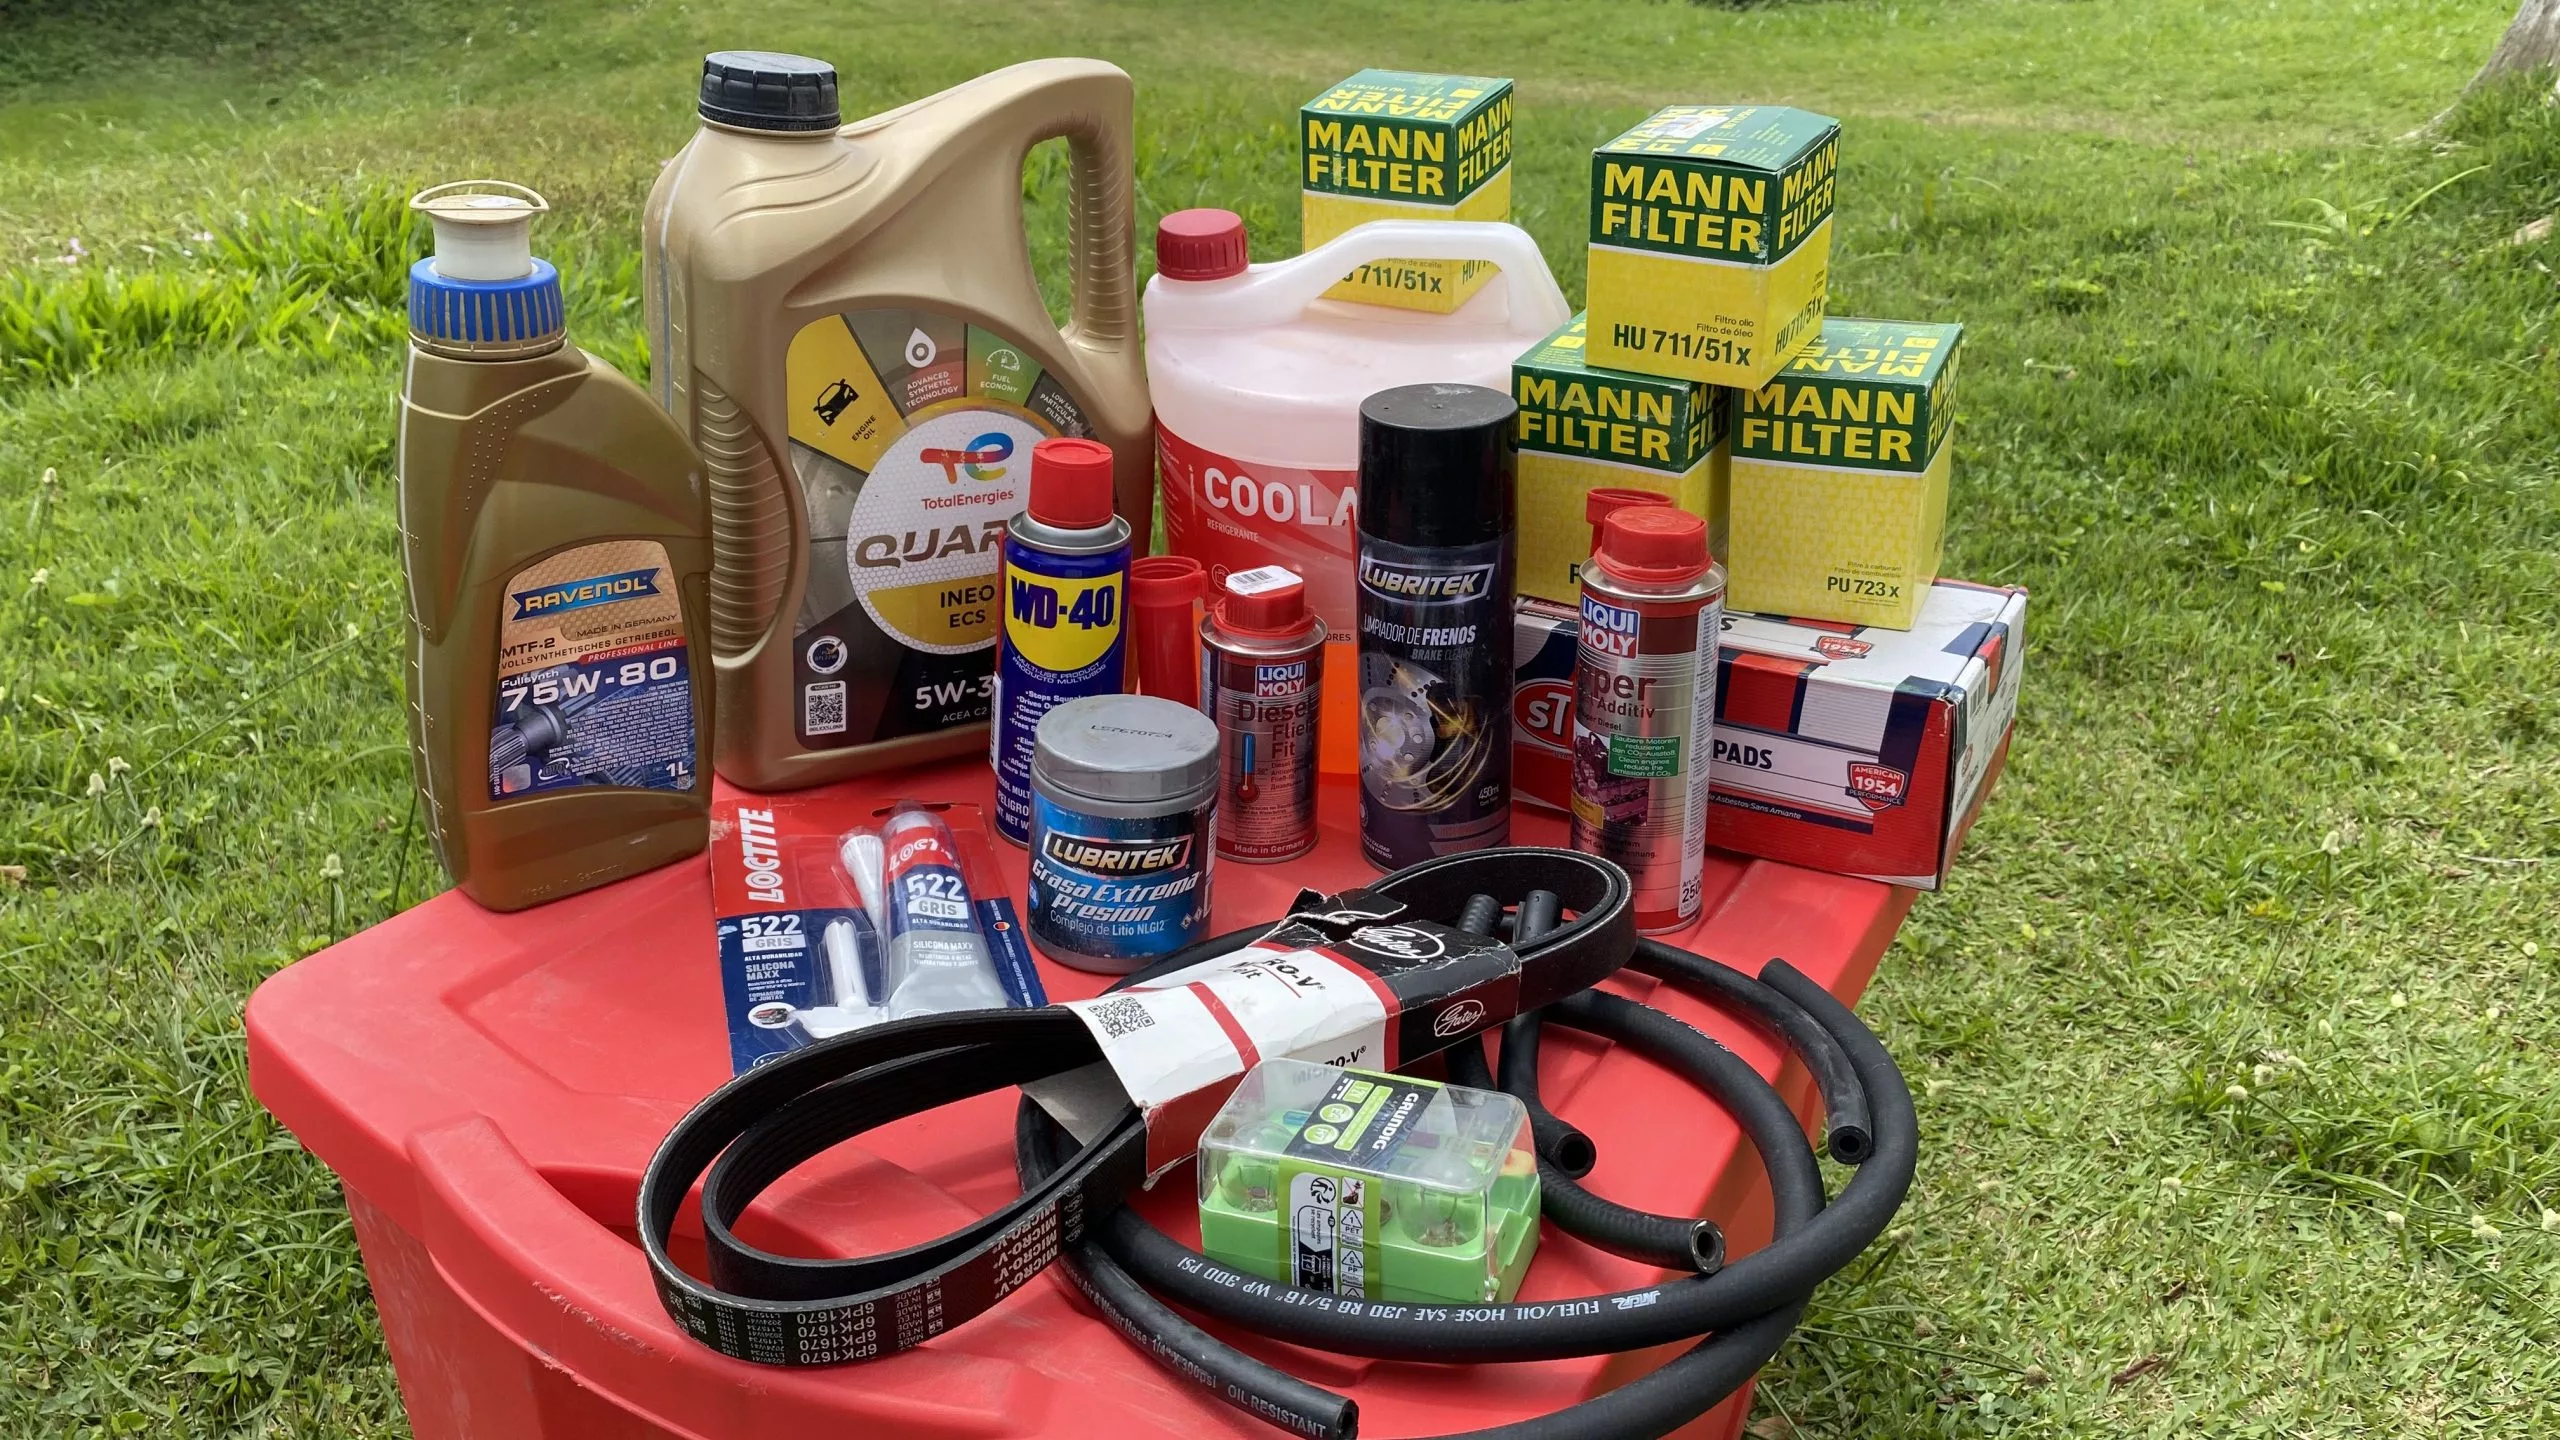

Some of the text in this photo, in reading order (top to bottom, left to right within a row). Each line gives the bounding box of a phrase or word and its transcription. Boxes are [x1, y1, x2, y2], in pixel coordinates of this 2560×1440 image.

[1313, 98, 1457, 120] MANN
[1329, 89, 1470, 109] FILTER
[1459, 93, 1513, 159] MANN
[1309, 120, 1444, 162] MANN
[1458, 127, 1511, 193] FILTER
[1309, 154, 1444, 196] FILTER
[1781, 136, 1840, 212] MANN
[1604, 163, 1766, 215] MANN
[1778, 175, 1834, 250] FILTER
[1602, 202, 1761, 253] FILTER
[1361, 265, 1442, 294] 711/51x
[1696, 323, 1753, 338] Filtro de óleo
[1714, 314, 1754, 328] Filtro olio
[1613, 323, 1751, 367] HU 711/51x
[907, 370, 949, 391] ADVANCED
[908, 378, 951, 399] SYNTHETIC
[980, 381, 1018, 393] ECONOMY
[992, 374, 1011, 384] FUEL
[906, 385, 958, 408] TECHNOLOGY
[1051, 391, 1065, 405] LOW
[1519, 375, 1672, 426] MANN
[1743, 383, 1915, 426] MANN
[1045, 407, 1066, 426] FILTER
[851, 414, 876, 441] ENGINE
[863, 428, 876, 441] OIL
[1519, 410, 1670, 462] FILTER
[1742, 419, 1912, 462] FILTER
[921, 488, 1014, 511] TotalEnergies
[1207, 517, 1259, 543] REFRIGERANTE
[1364, 569, 1480, 595] LUBRITEK
[1827, 576, 1899, 598] PU 723 x
[525, 576, 647, 612] RAVENOL
[940, 584, 995, 608] INEO
[1011, 575, 1115, 630] WD-40
[576, 614, 677, 638] MADE IN GERMANY
[950, 609, 985, 628] ECS
[1582, 598, 1634, 633] LIQUI
[1364, 614, 1477, 646] LIMPIADOR DE FRENOS
[1582, 621, 1636, 656] MOLY
[501, 637, 556, 659] MTF-2
[501, 640, 611, 669] VOLLSYNTHETISCHES
[588, 639, 678, 663] PROFESSIONAL LINE
[1412, 648, 1442, 661] BRAKE
[1822, 642, 1861, 653] 1954
[1012, 657, 1054, 684] PRODUCTO
[1016, 655, 1100, 679] MULTI-USE PRODUCT
[1258, 663, 1304, 682] LIQUI
[501, 669, 559, 689] Fullsynth
[501, 656, 677, 712] 75W-80
[1258, 678, 1304, 696] MOLY
[941, 709, 970, 723] ACEA
[1598, 698, 1655, 719] Additiv
[1598, 717, 1621, 731] Diesel
[1272, 742, 1296, 759] Fit
[1645, 737, 1676, 745] Motoren
[1712, 739, 1773, 770] PADS
[666, 761, 689, 778] 1L
[1613, 768, 1648, 777] emission
[1624, 763, 1650, 771] reduce
[1854, 766, 1900, 780] AMERICAN
[1478, 784, 1499, 800] 450ml
[1855, 776, 1897, 795] 1954
[997, 789, 1029, 816] PELIGRO
[1849, 788, 1902, 805] PERFORMANCE
[1005, 812, 1018, 826] NET
[1750, 803, 1801, 819] Sans Amiante
[738, 807, 785, 904] LOCTITE
[1053, 838, 1181, 870] LUBRITEK
[1234, 844, 1257, 854] Made
[1270, 840, 1305, 854] Germany
[906, 873, 965, 901] 522
[1032, 859, 1203, 903] Grasa Extrema
[918, 901, 957, 916] GRIS
[1051, 892, 1156, 922] Presión
[741, 914, 802, 939] 522
[1050, 911, 1165, 936] Complejo de Litio NLGI2
[755, 937, 793, 949] GRIS
[913, 941, 974, 950] SILICONA MAXX
[745, 961, 796, 973] SILICONA
[746, 970, 780, 981] MAXX
[1441, 1003, 1479, 1031] Gates
[1372, 1092, 1419, 1151] GRUNDIG
[1345, 1227, 1359, 1235] PET
[1177, 1256, 1201, 1274] PSI
[1203, 1266, 1241, 1288] 300
[895, 1288, 921, 1301] MADE
[1243, 1281, 1271, 1298] WP
[797, 1302, 874, 1324] 6PK1670
[896, 1300, 909, 1308] EU
[896, 1303, 921, 1317] MADE
[1338, 1301, 1364, 1316] R6
[1369, 1304, 1407, 1319] J30
[1414, 1308, 1448, 1321] SAE
[1456, 1308, 1506, 1321] HOSE
[1515, 1300, 1600, 1321] FUEL/OIL
[798, 1316, 875, 1338] 6PK1670
[898, 1315, 910, 1325] EU
[898, 1318, 923, 1331] MADE
[799, 1329, 877, 1350] 6PK1670
[899, 1331, 911, 1340] EU
[800, 1343, 877, 1363] 6PK1670
[1081, 1281, 1095, 1300] Air
[1100, 1297, 1126, 1324] Water
[1124, 1318, 1148, 1346] Hose
[1180, 1357, 1217, 1390] 300psi
[1228, 1384, 1249, 1407] OIL
[1250, 1394, 1327, 1438] RESISTANT
